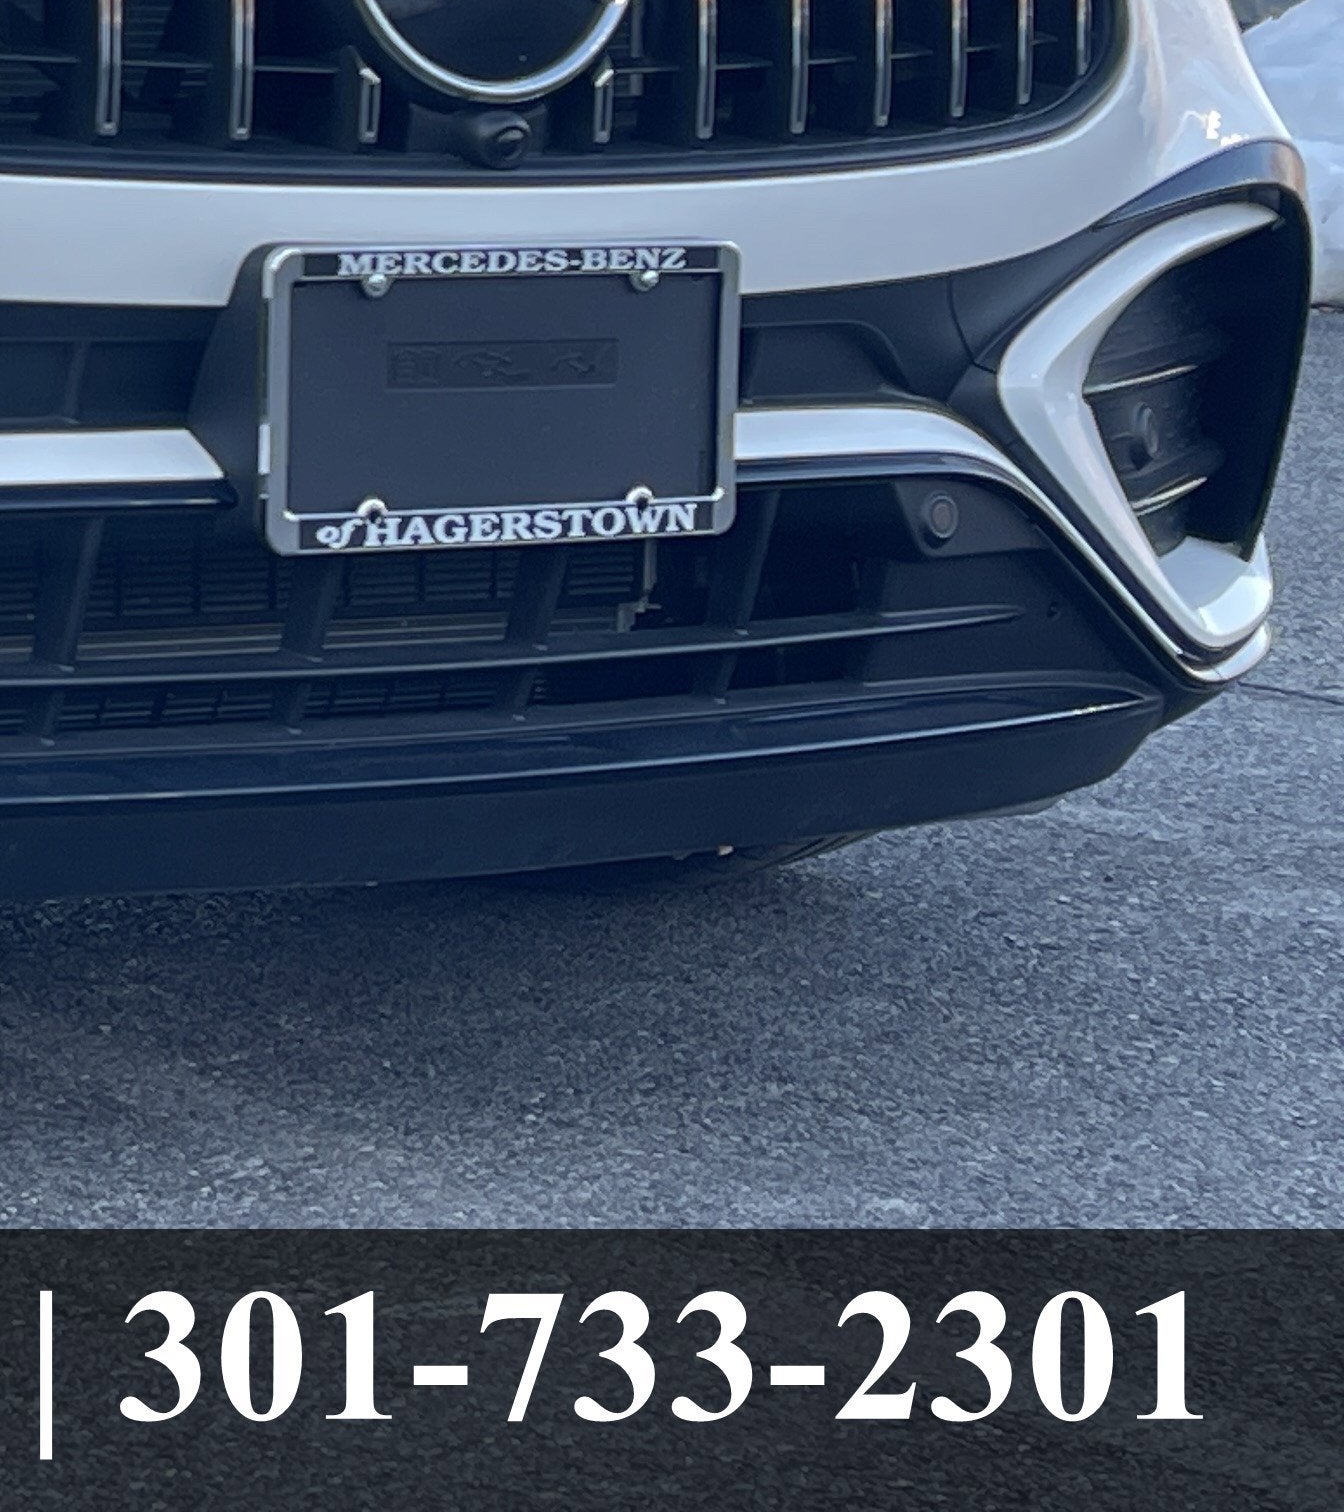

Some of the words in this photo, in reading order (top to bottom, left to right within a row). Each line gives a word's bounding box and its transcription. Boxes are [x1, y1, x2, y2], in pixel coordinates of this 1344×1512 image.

[336, 247, 687, 277] MERCEDES-BENZ
[316, 515, 362, 550] of
[363, 503, 699, 549] HAGERSTOWN
